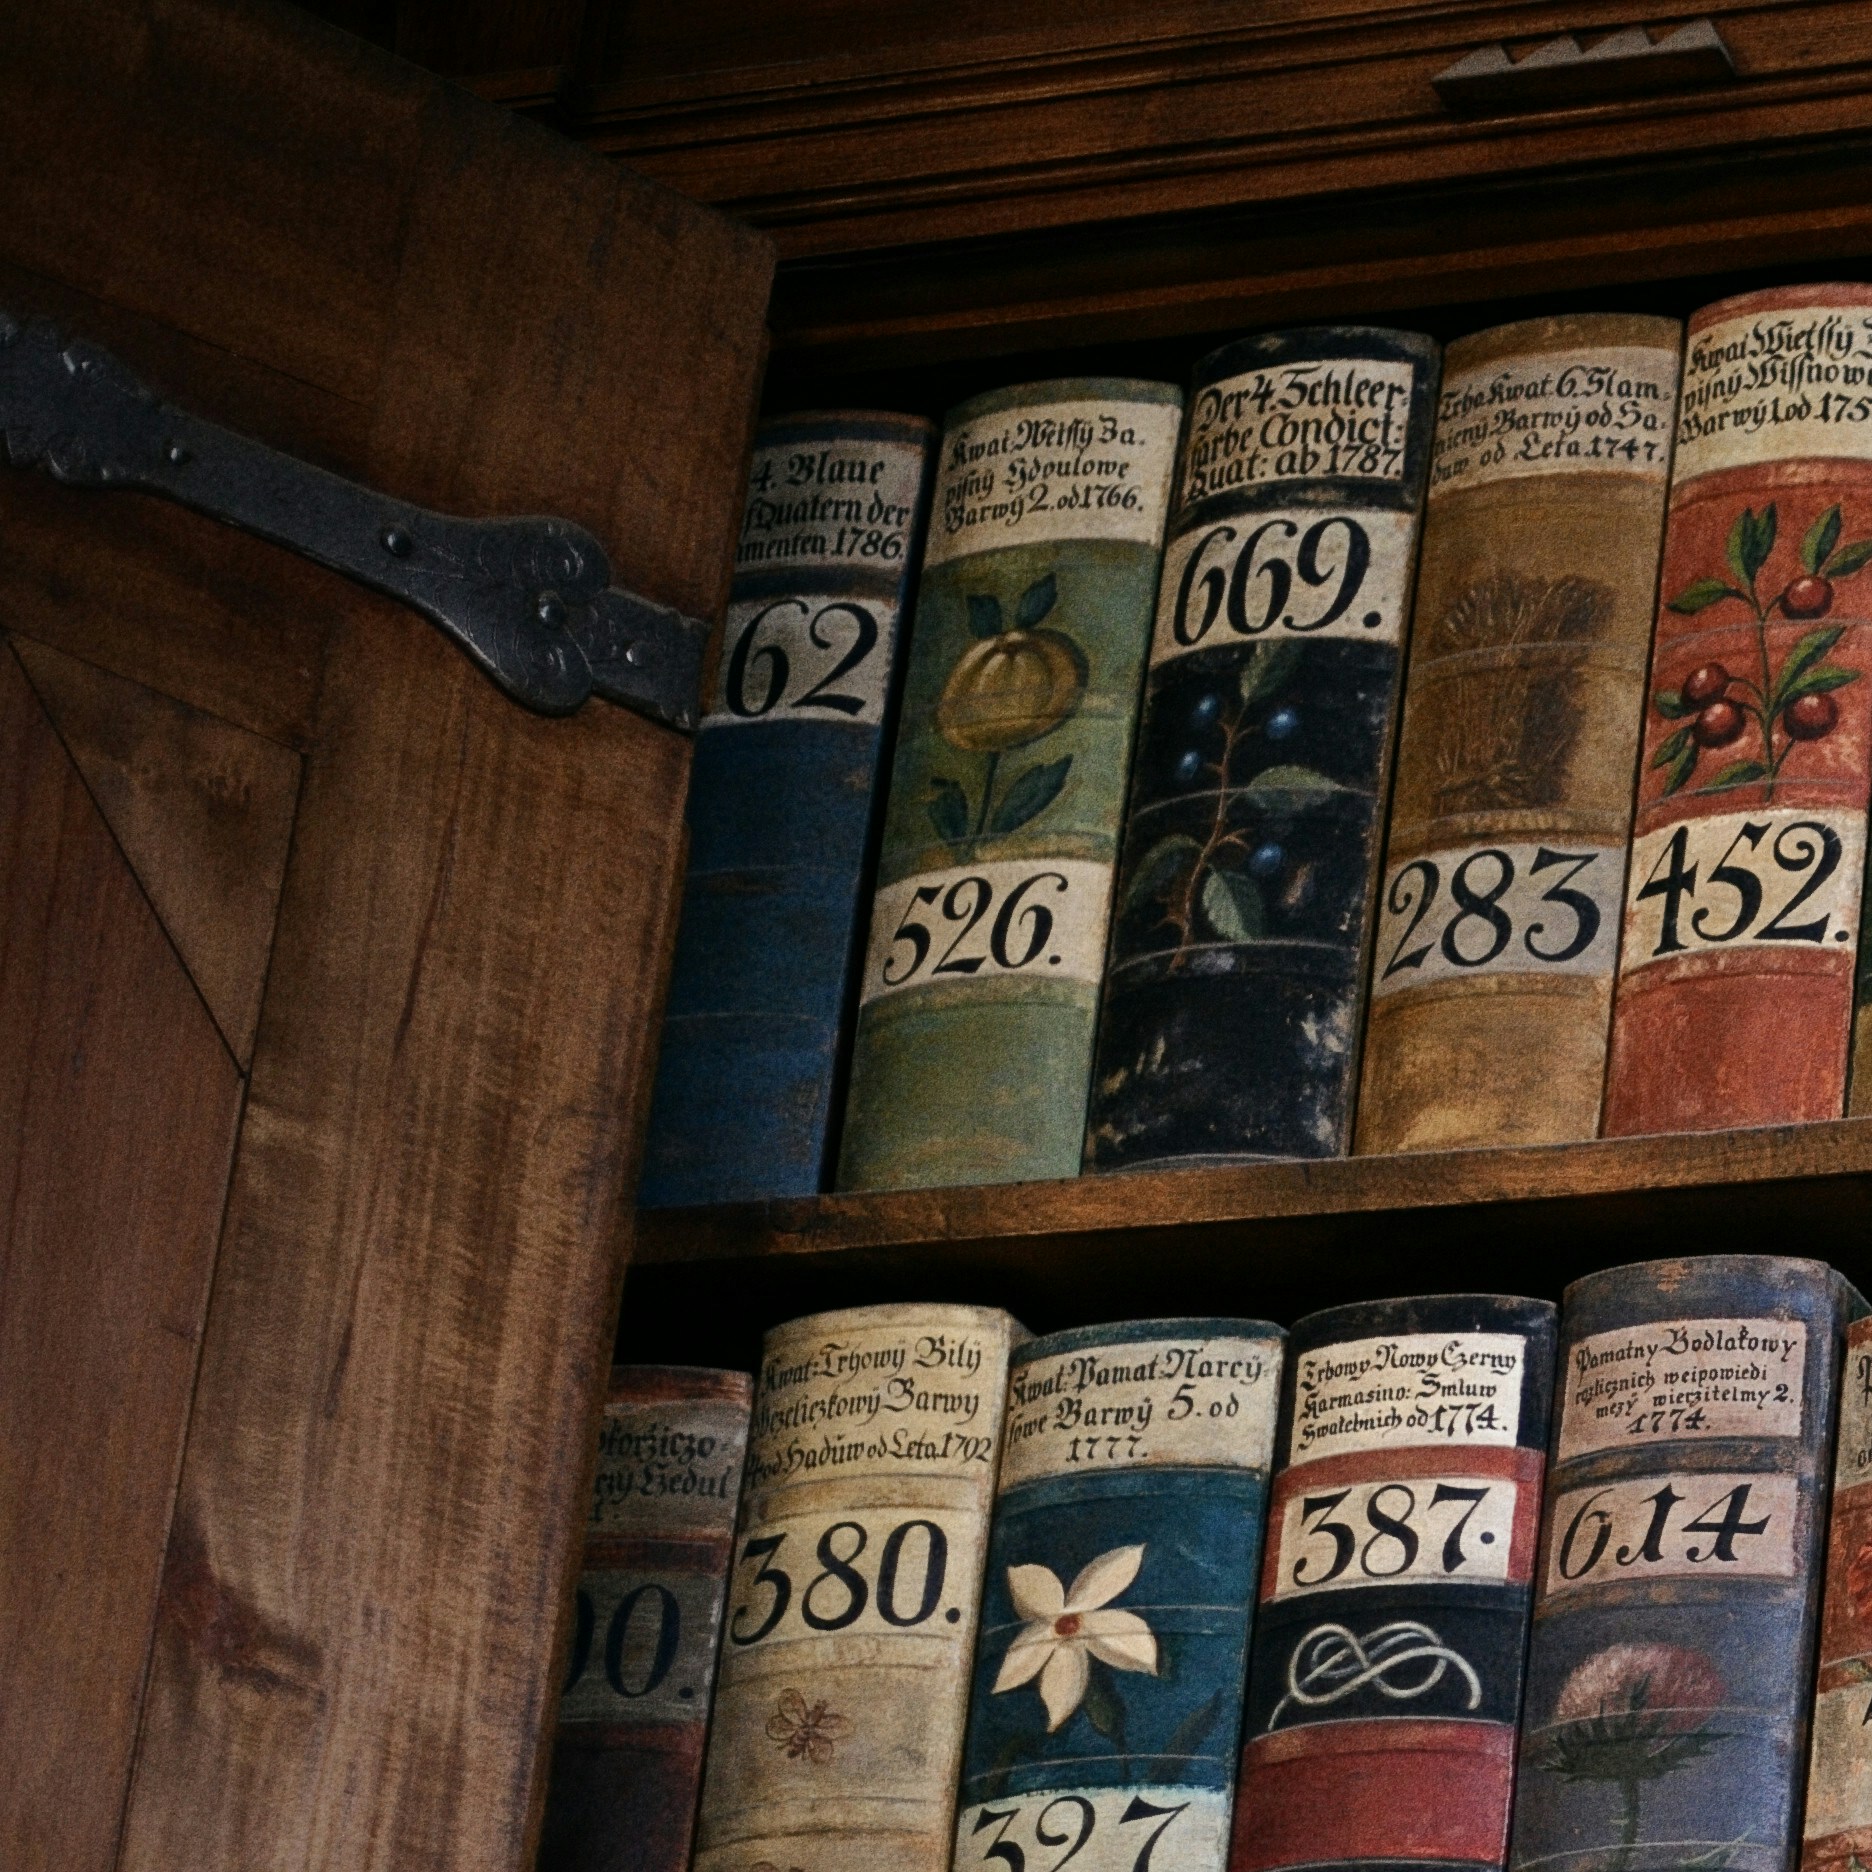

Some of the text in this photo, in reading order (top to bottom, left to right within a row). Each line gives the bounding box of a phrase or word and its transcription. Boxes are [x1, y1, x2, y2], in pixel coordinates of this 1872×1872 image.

[1324, 444, 1403, 478] 1787.
[1173, 515, 1384, 648] 669.
[725, 600, 877, 718] 62
[884, 871, 1068, 985] 526.
[1385, 850, 1602, 983] 283
[1637, 821, 1851, 947] 452.
[1064, 1433, 1149, 1463] 1777.
[1167, 1383, 1240, 1421] 5. od
[1428, 1403, 1508, 1438] 1774.
[1626, 1407, 1712, 1436] 1774.
[729, 1519, 960, 1646] 380.
[1291, 1482, 1495, 1587] 387.
[1557, 1480, 1772, 1582] 614
